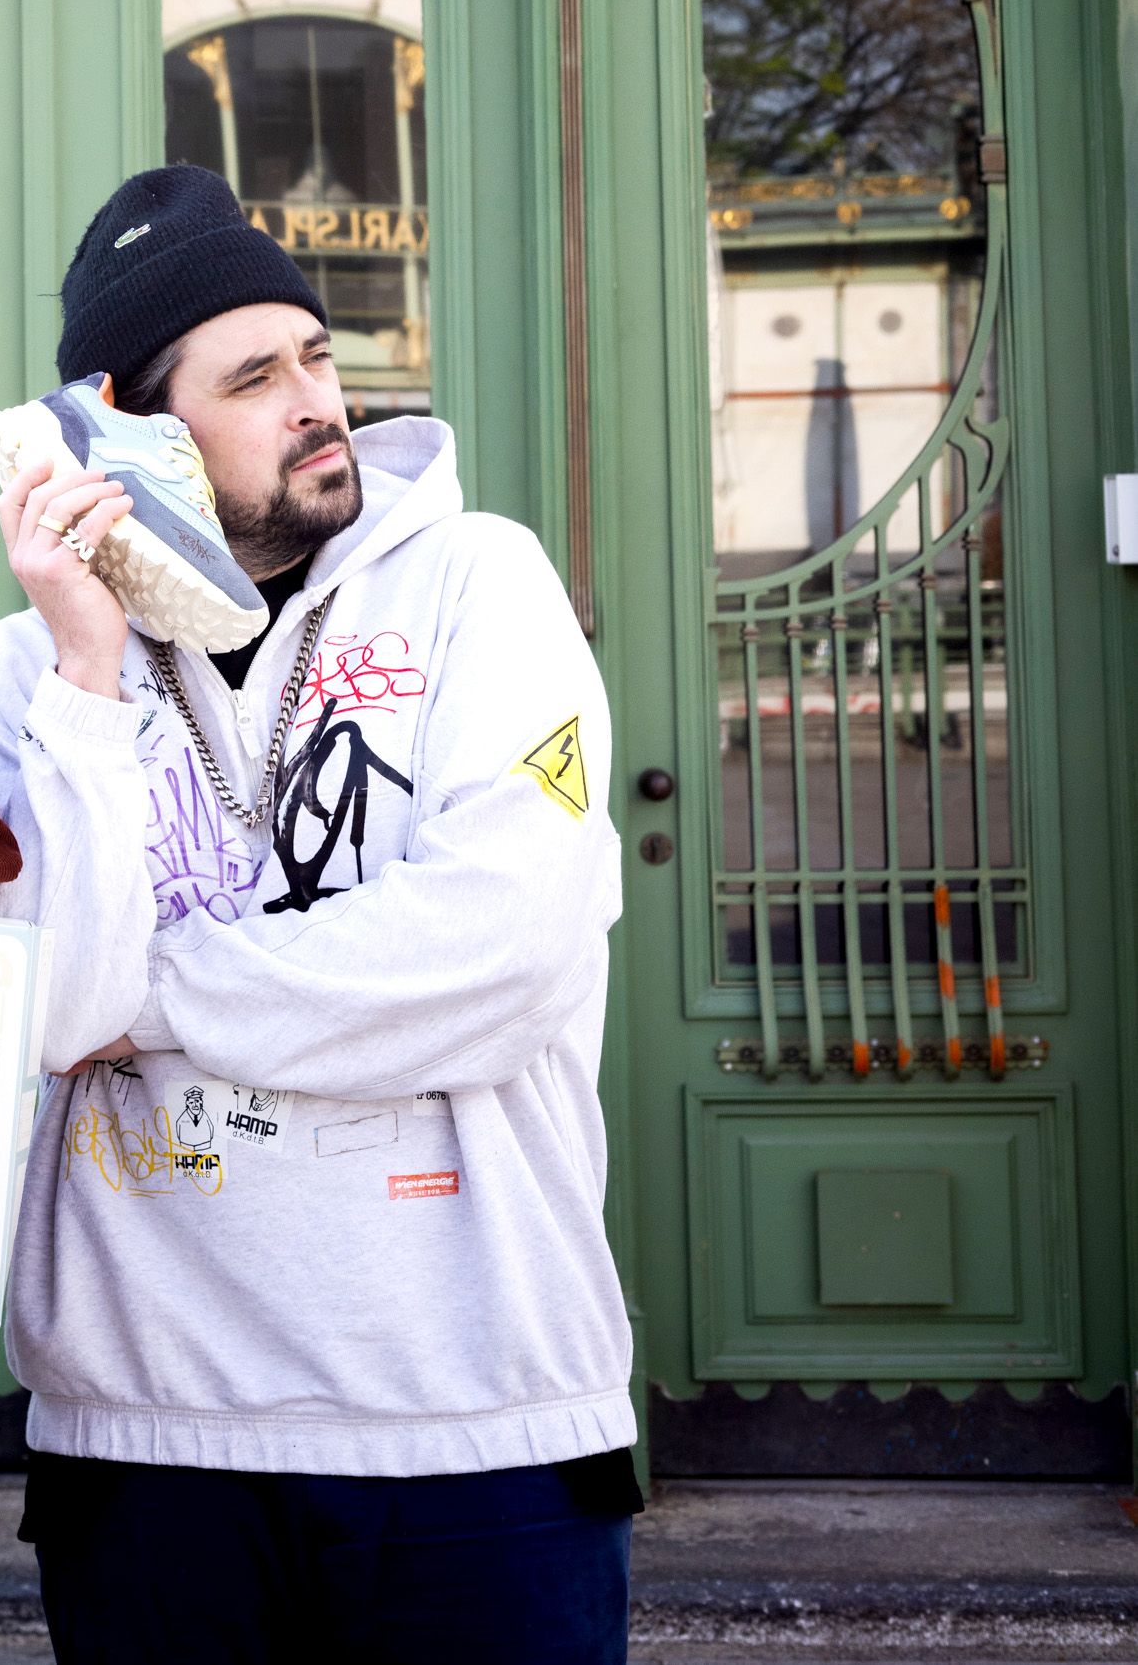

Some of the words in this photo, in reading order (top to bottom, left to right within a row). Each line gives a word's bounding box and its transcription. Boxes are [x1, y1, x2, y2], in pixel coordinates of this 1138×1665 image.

[426, 1091, 447, 1100] 0676
[226, 1110, 278, 1137] KAMP
[174, 1154, 220, 1170] KAMP
